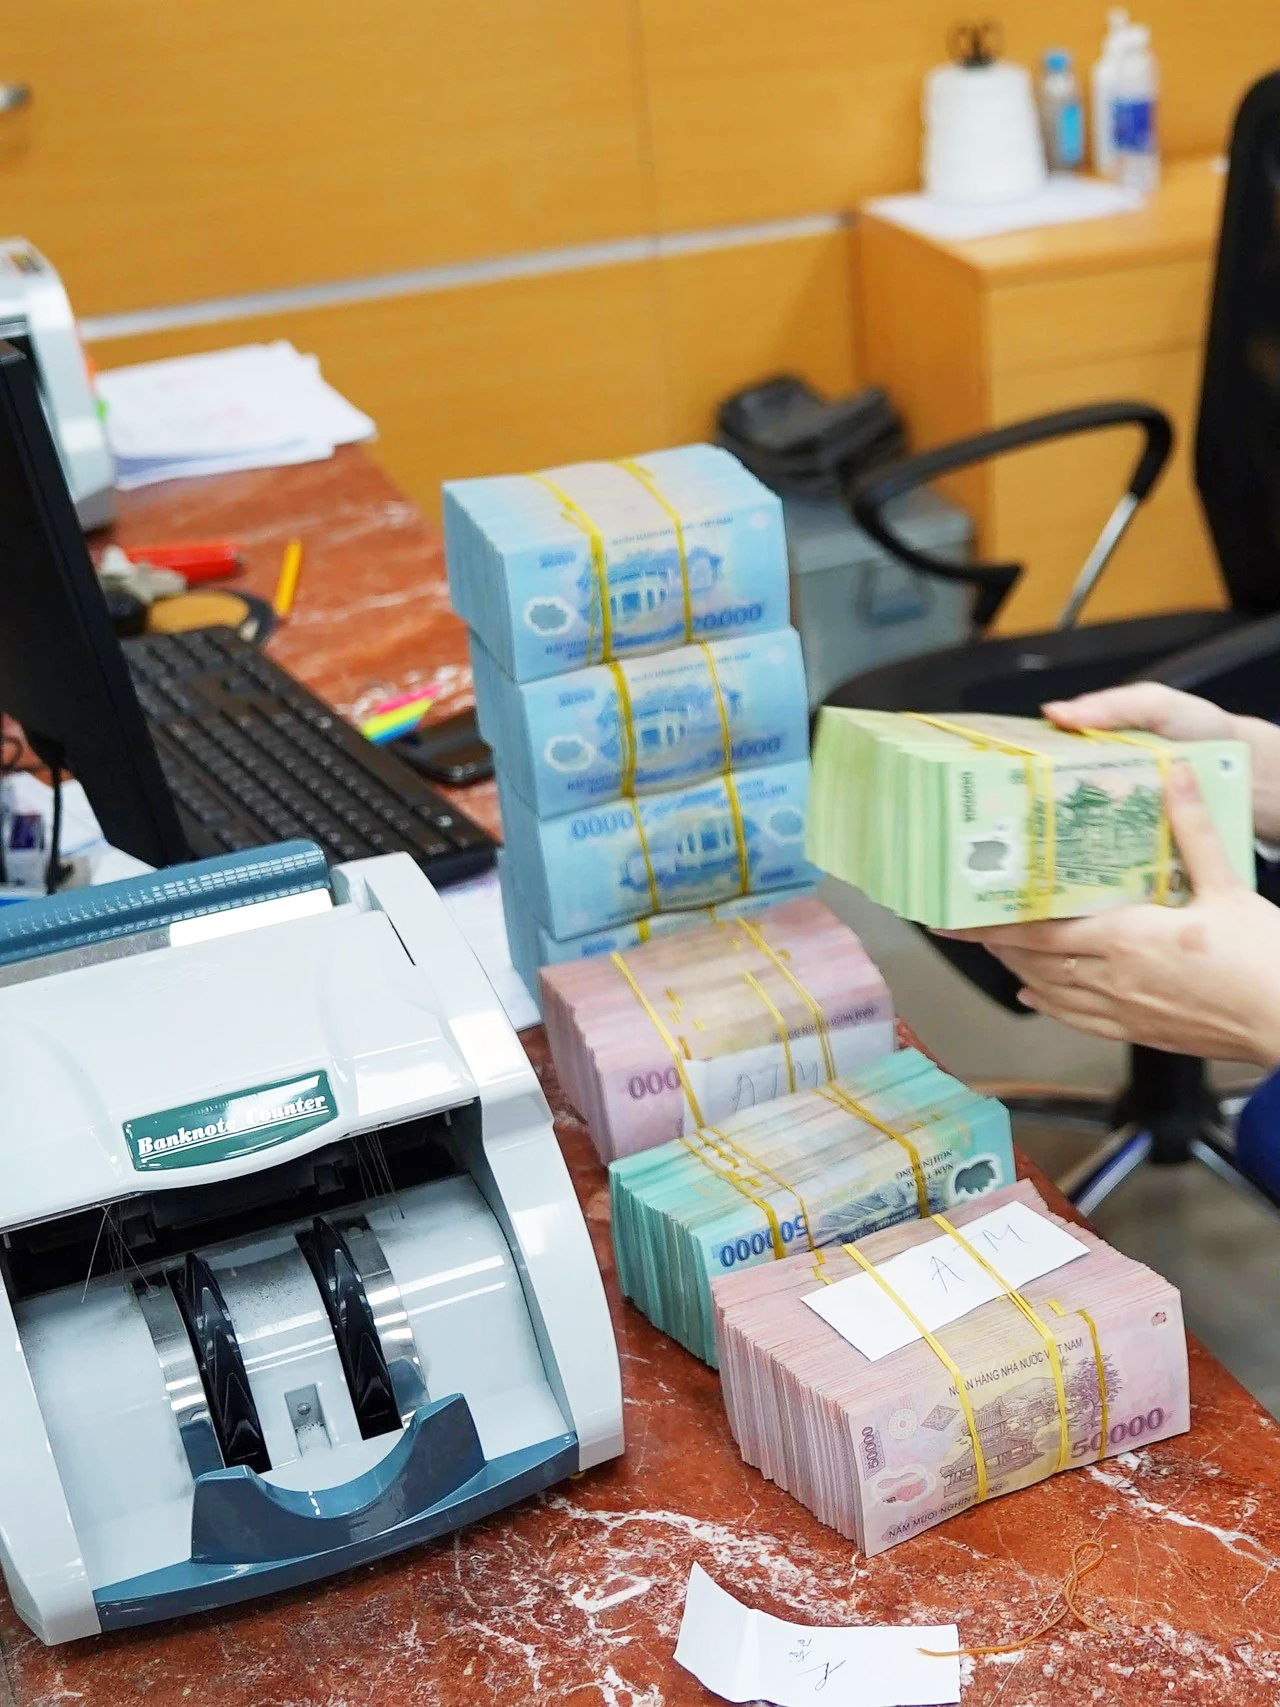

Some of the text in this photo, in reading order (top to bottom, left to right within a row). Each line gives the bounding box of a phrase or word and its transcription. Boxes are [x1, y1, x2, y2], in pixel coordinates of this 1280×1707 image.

[628, 1067, 681, 1101] 000
[137, 1094, 326, 1156] Banknote Counter
[1064, 1336, 1084, 1354] NAM
